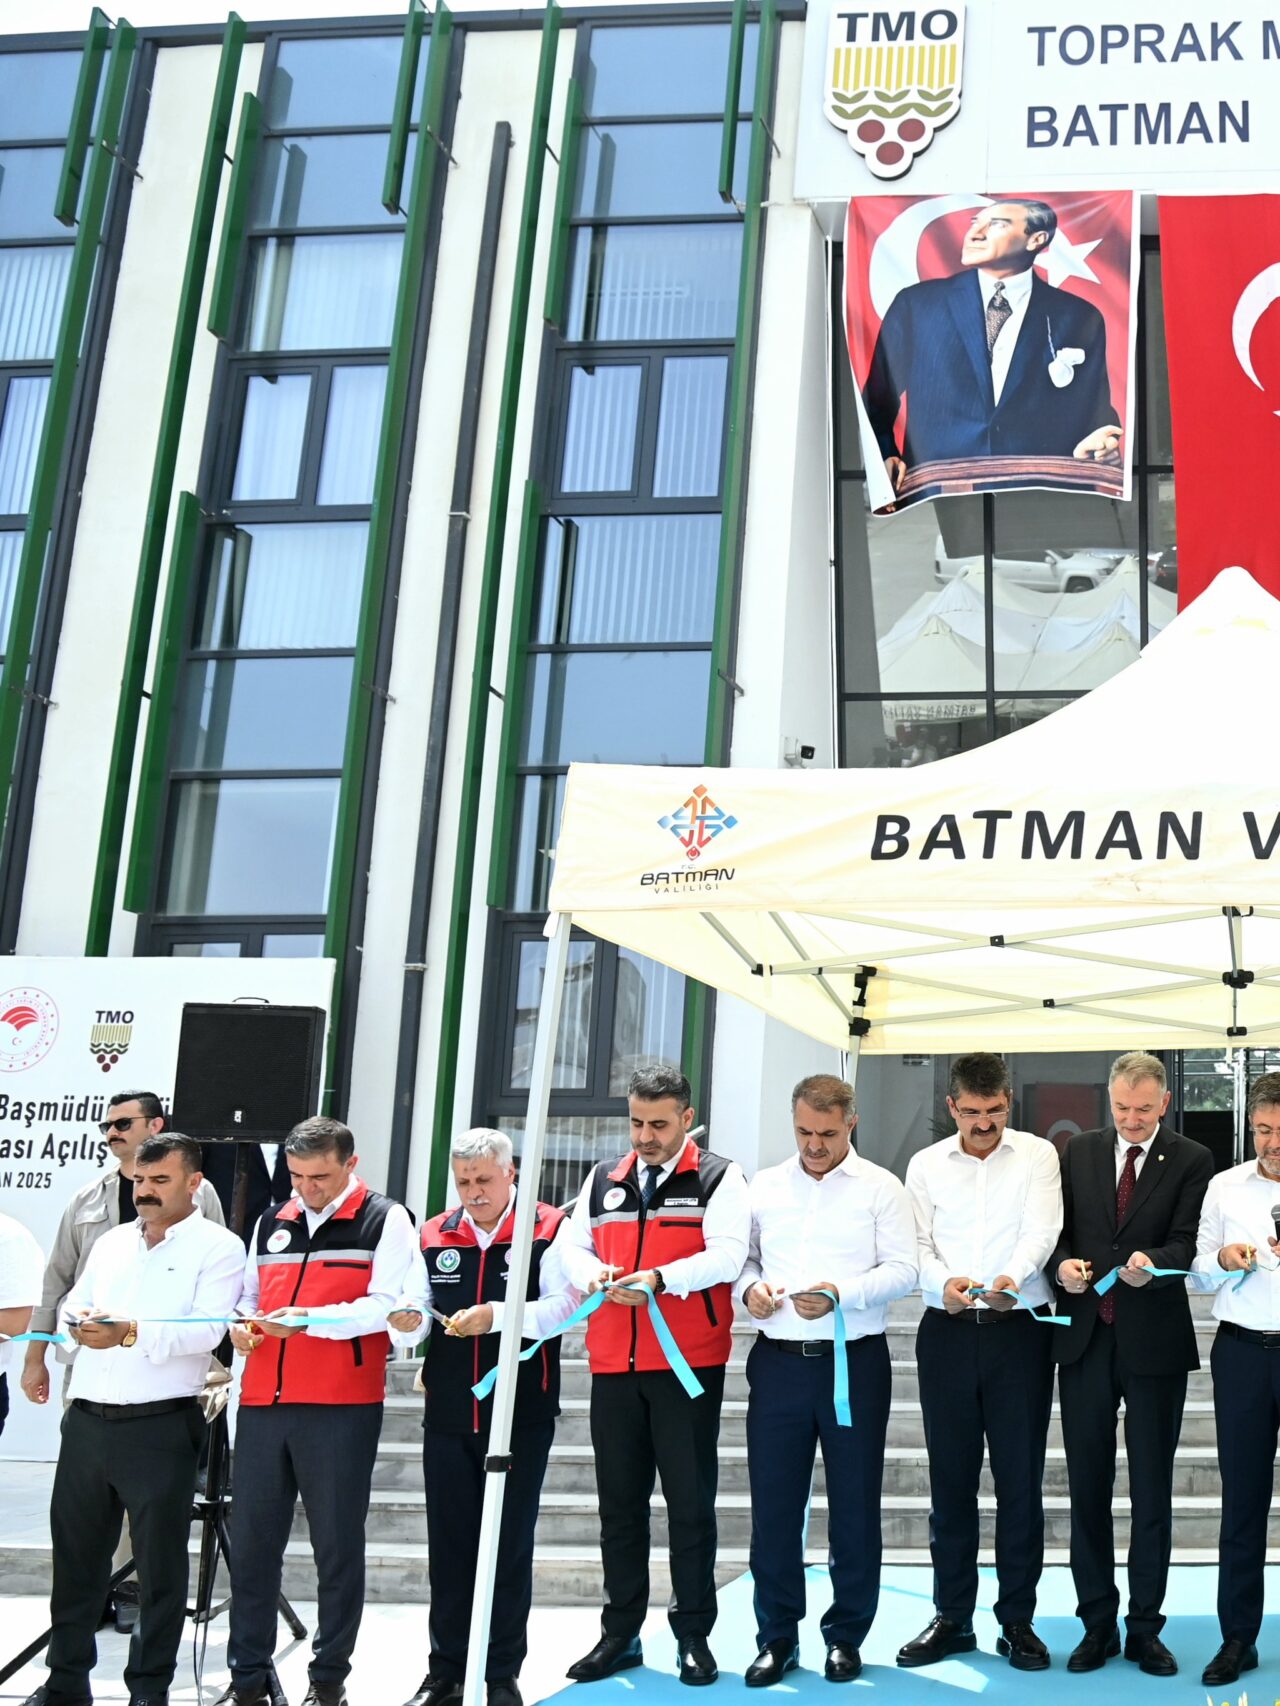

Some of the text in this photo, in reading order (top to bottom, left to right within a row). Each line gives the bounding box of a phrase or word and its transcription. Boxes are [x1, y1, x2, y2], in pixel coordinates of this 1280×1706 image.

[838, 10, 958, 42] TMO
[1026, 20, 1244, 67] TOPRAK
[1026, 100, 1250, 149] BATMAN
[870, 809, 1203, 861] BATMAN
[640, 867, 735, 886] BATMAN
[95, 1010, 135, 1024] TMO
[16, 1171, 52, 1189] 2025
